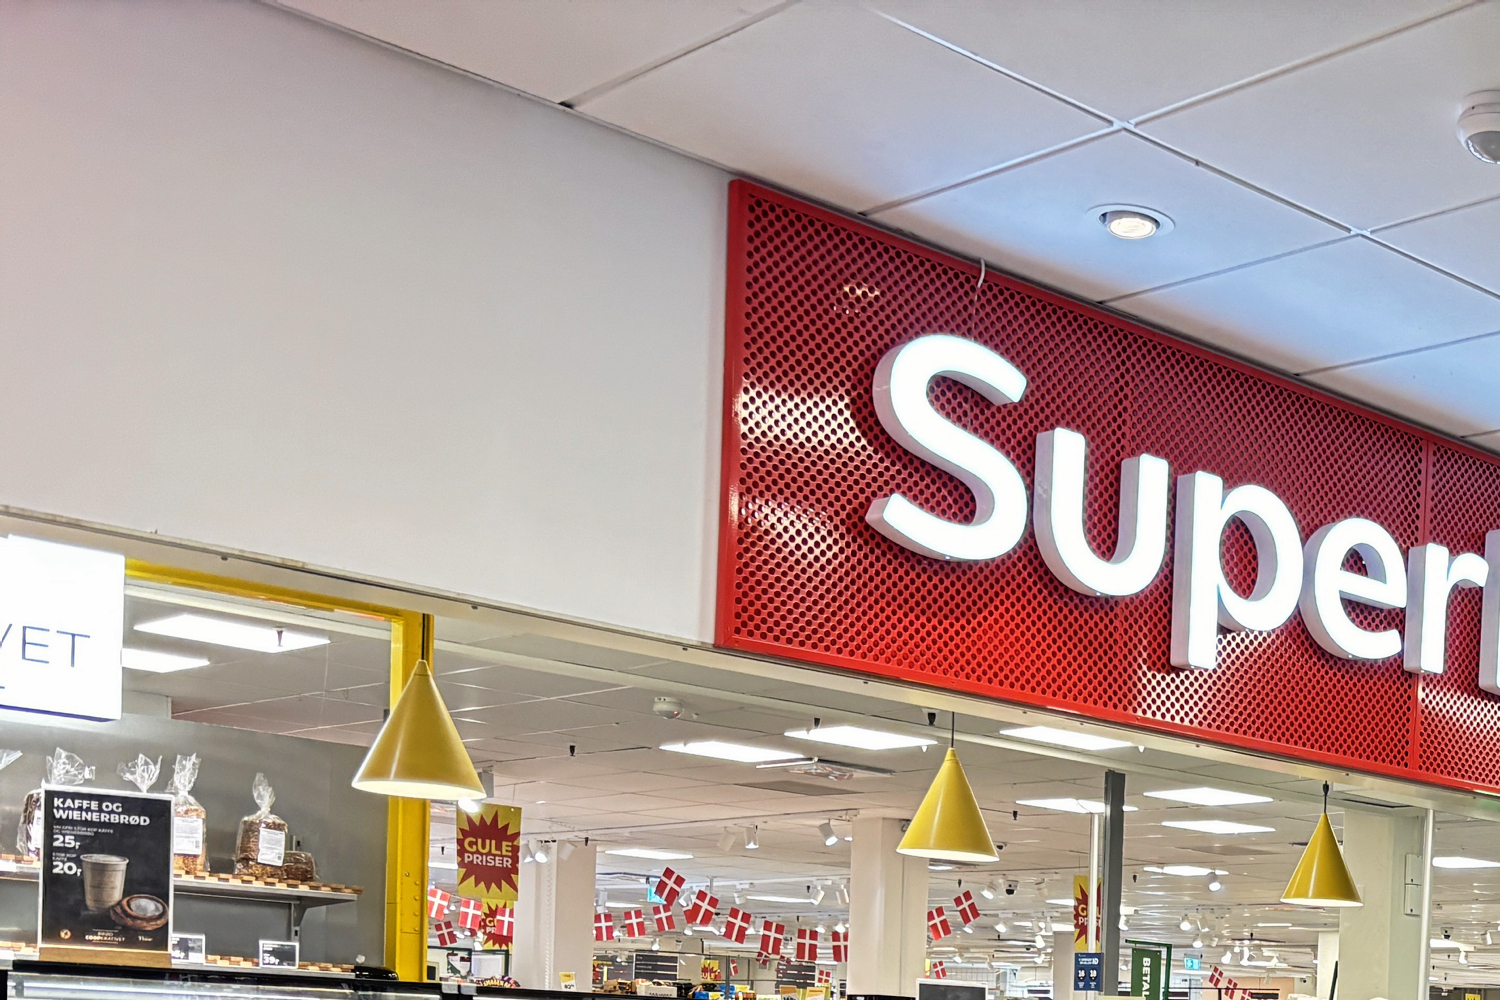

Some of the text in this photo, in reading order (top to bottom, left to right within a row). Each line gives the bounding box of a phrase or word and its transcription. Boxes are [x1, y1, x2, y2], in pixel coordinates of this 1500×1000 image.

[53, 797, 122, 813] KAFFE OG
[53, 808, 150, 826] WIENERBRØD
[464, 837, 512, 856] GULE
[464, 852, 512, 868] PRISER
[1141, 957, 1151, 998] BETAL
